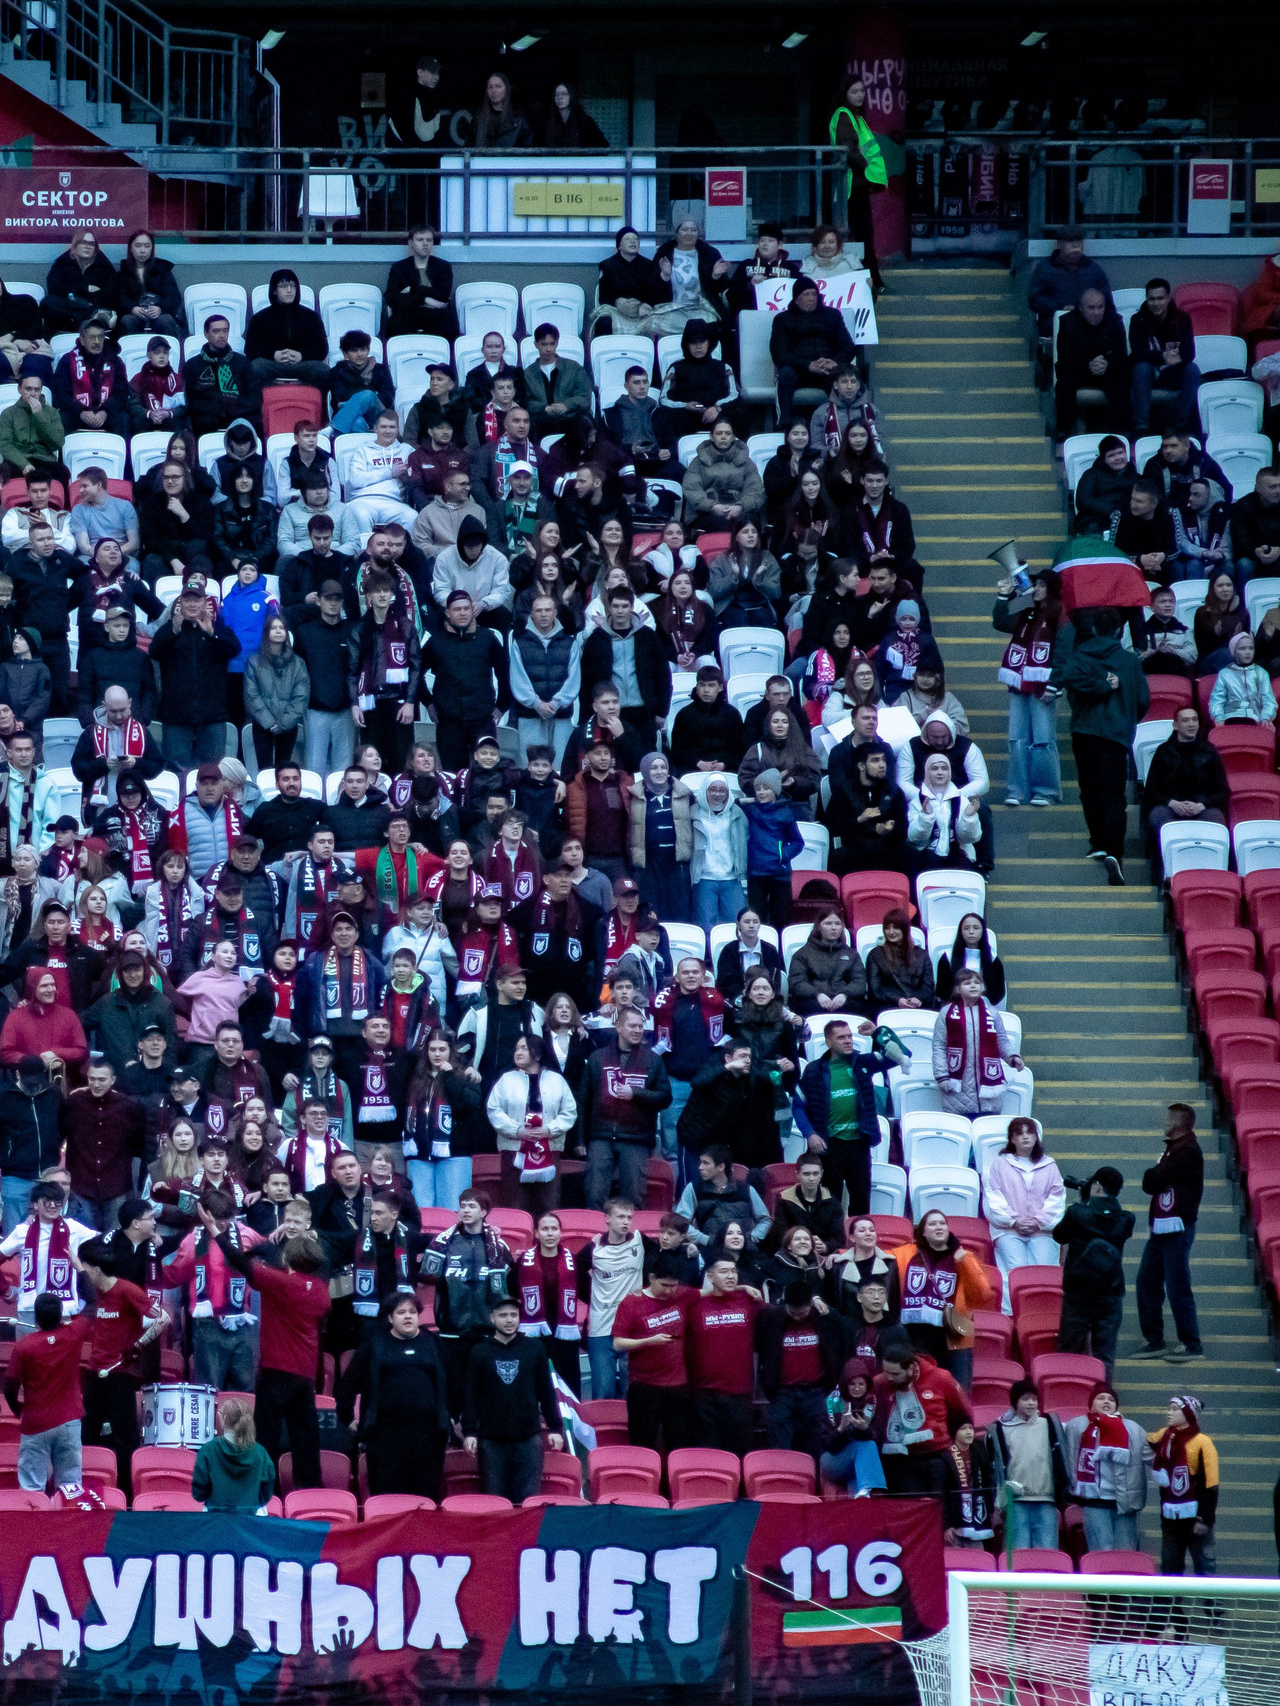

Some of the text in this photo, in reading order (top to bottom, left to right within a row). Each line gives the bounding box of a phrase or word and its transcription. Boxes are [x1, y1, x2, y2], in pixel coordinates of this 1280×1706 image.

[23, 190, 108, 206] СЕКТОР
[566, 194, 582, 204] 116
[5, 217, 125, 227] ВИКТОРА КОЛОТОВА
[384, 865, 393, 891] 1958
[363, 1096, 390, 1105] 1958
[191, 1393, 200, 1439] PIERRE CESAR
[780, 1540, 904, 1603] 116
[519, 1546, 718, 1647] НЕТ
